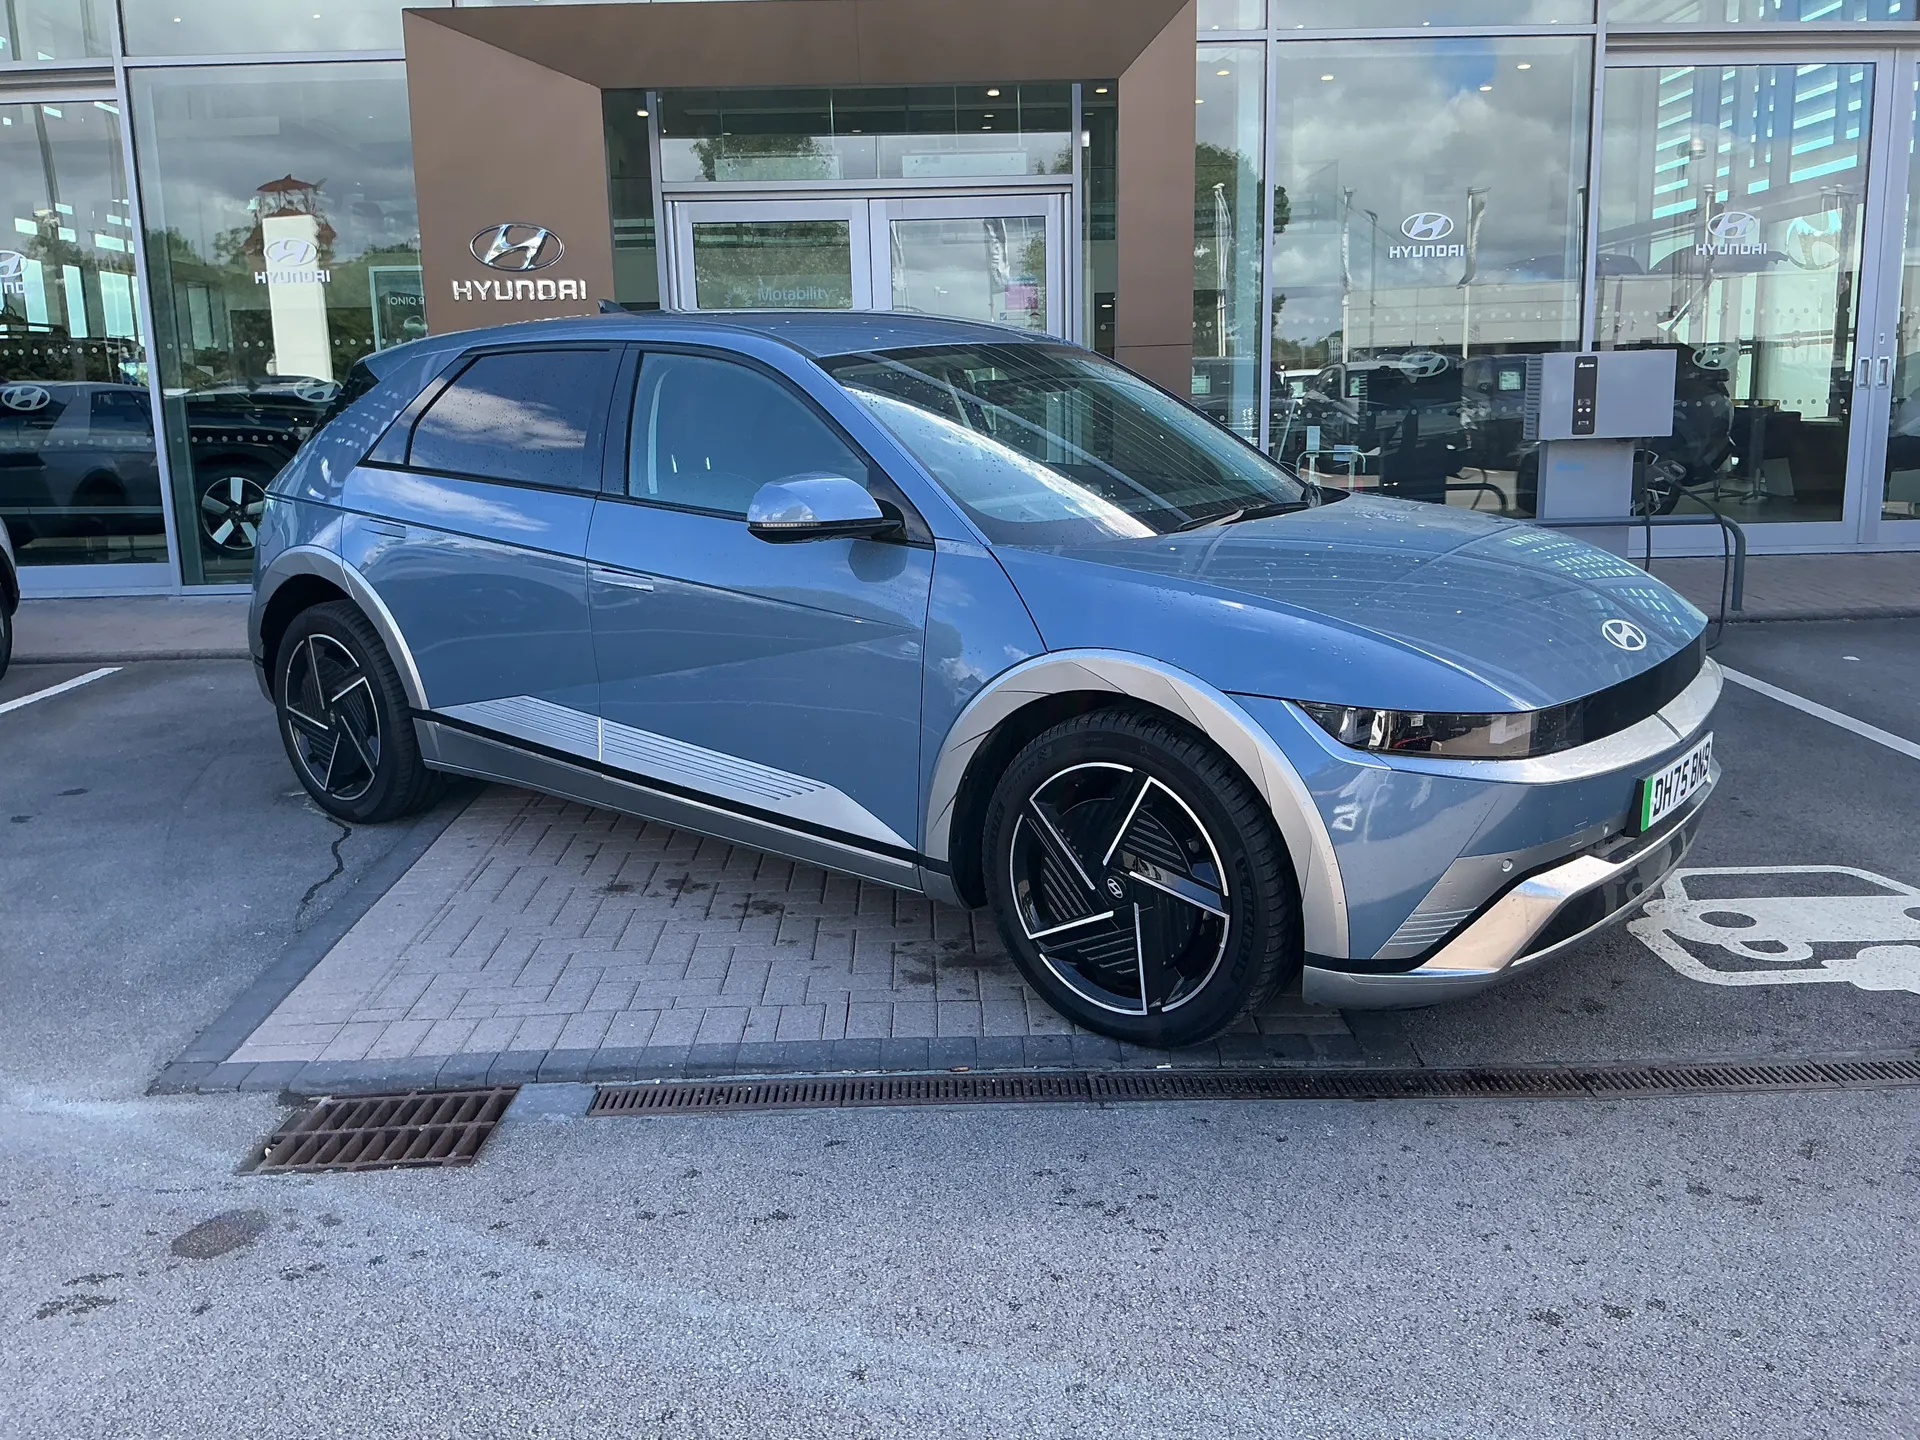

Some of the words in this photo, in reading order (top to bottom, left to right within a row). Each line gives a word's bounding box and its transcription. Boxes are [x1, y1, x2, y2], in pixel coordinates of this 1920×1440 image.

[1389, 244, 1464, 258] HYUNDAI
[1695, 243, 1767, 255] HYUNDAI
[254, 269, 331, 284] HYUNDAI
[452, 279, 587, 301] HYUNDAI
[757, 286, 830, 303] Motability
[387, 296, 416, 306] IONIQ
[1653, 759, 1690, 817] DH75
